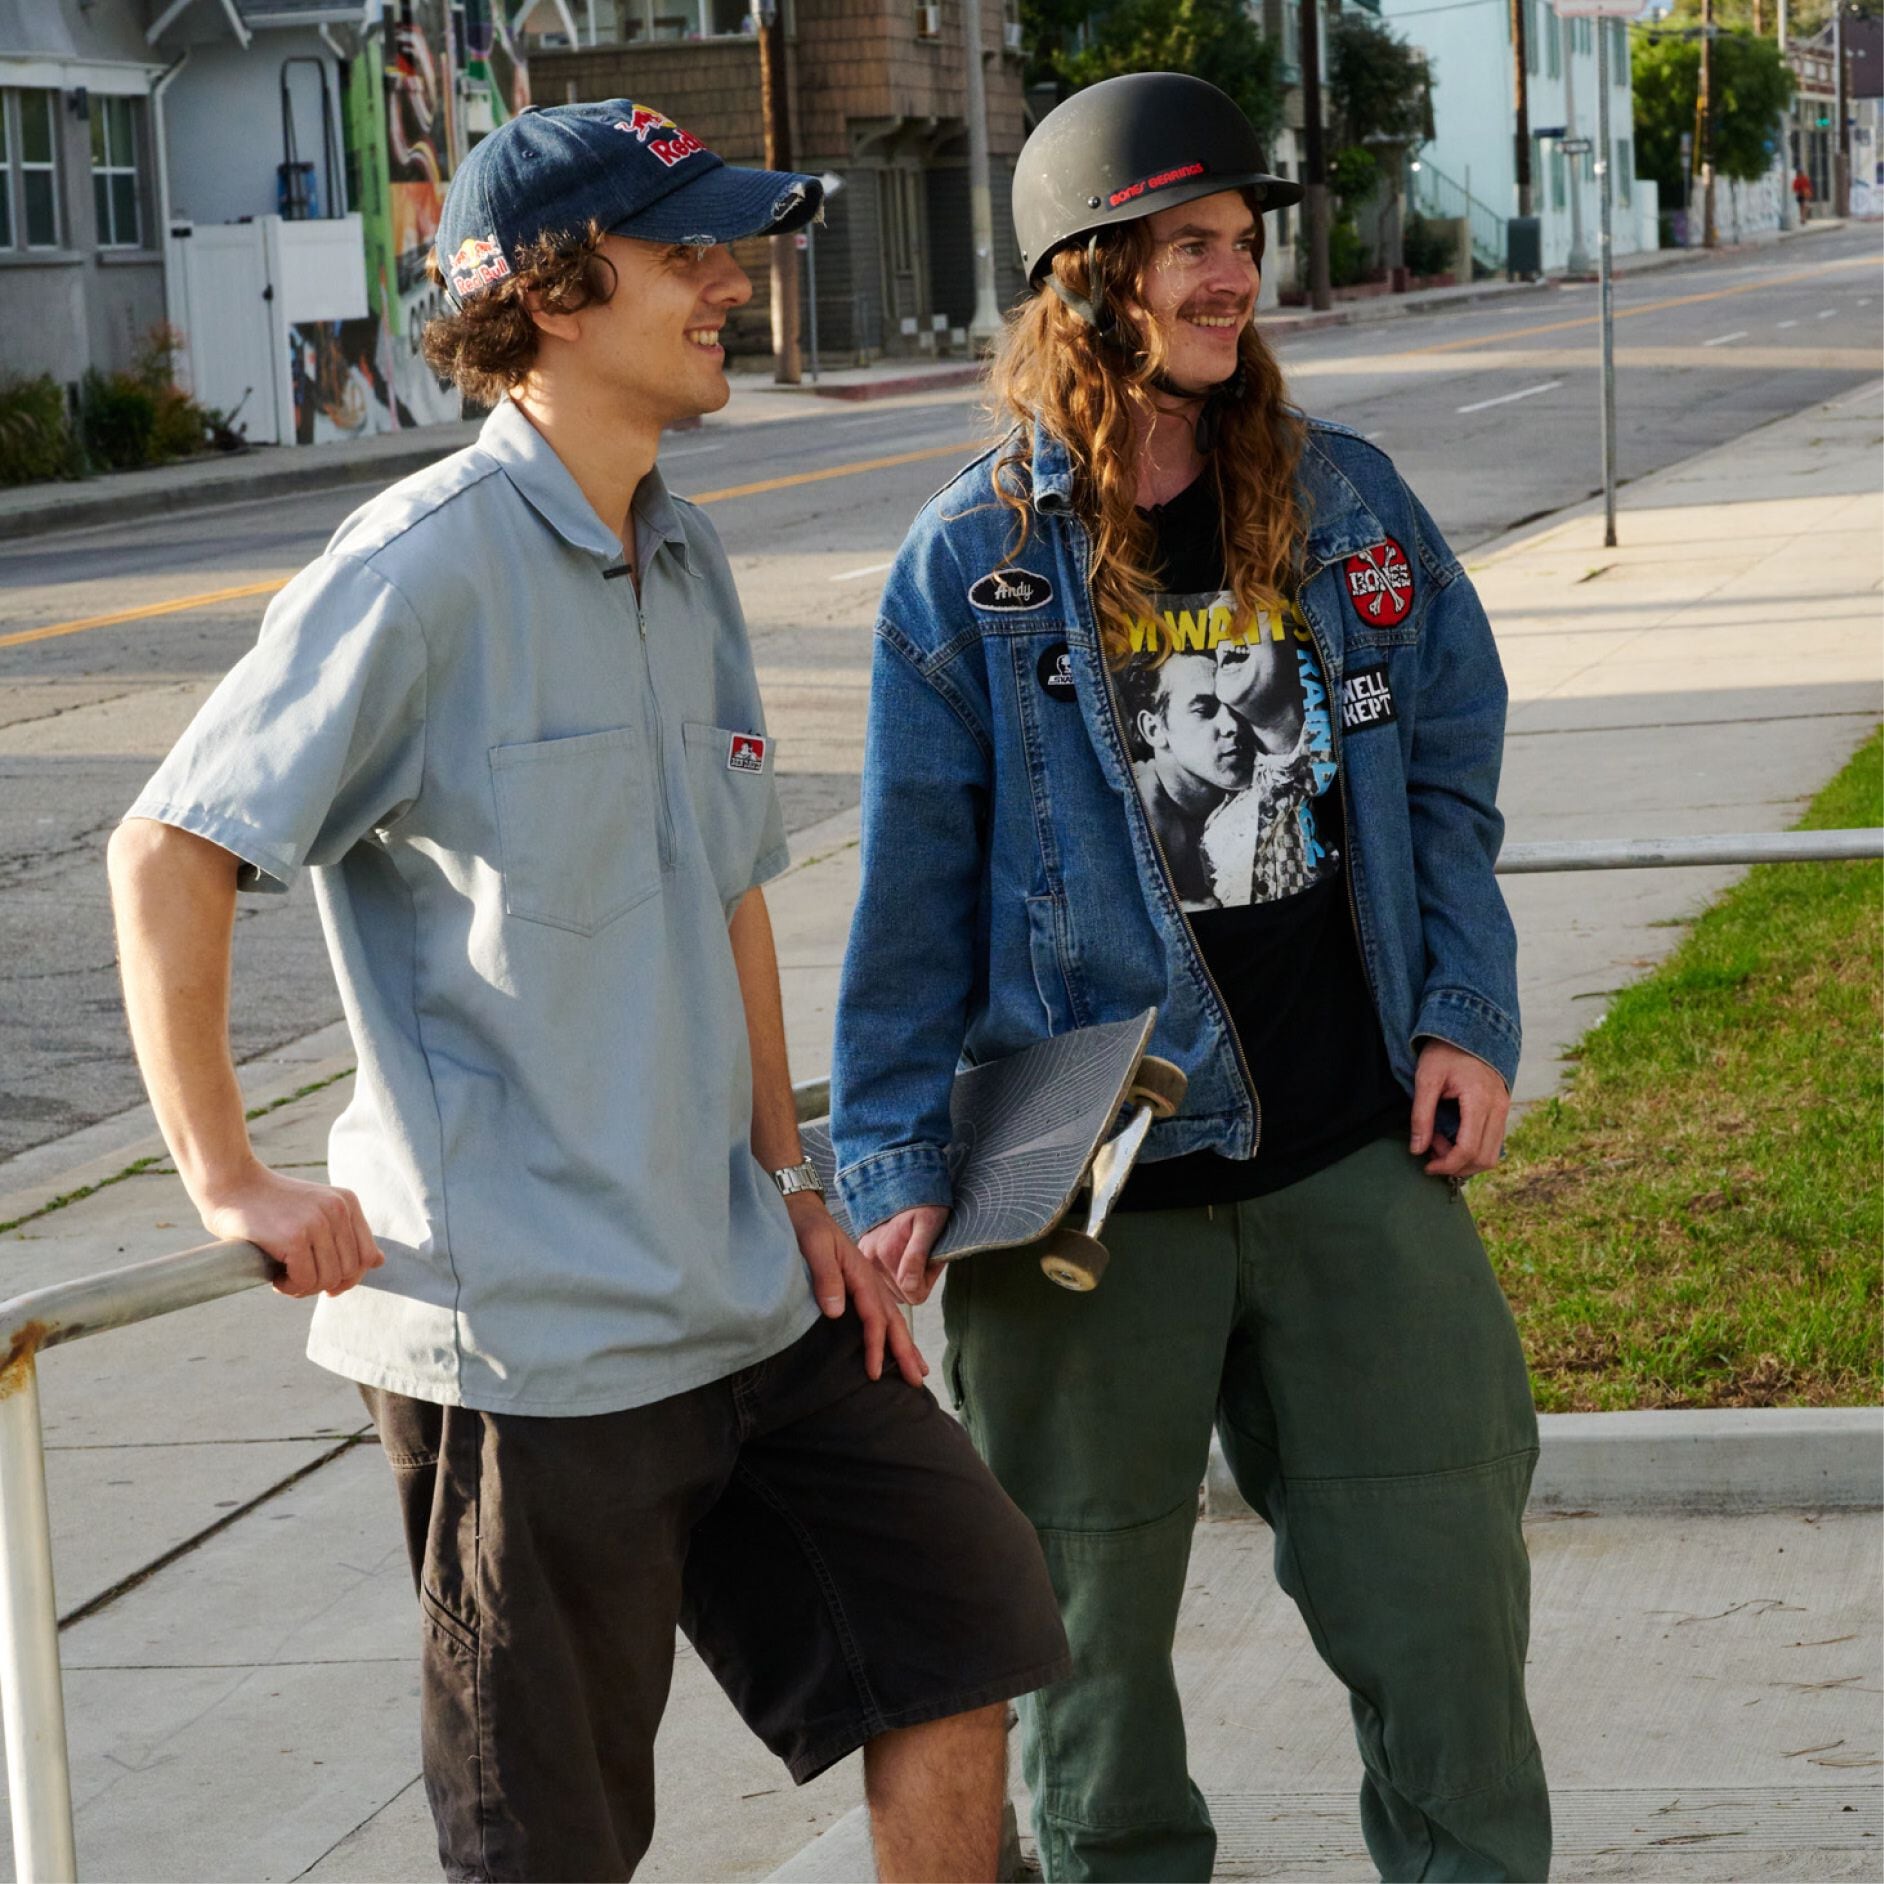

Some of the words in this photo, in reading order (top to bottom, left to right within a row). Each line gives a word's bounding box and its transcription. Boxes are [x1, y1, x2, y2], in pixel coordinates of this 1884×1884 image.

[647, 128, 706, 167] Red
[453, 276, 484, 296] Red
[478, 255, 511, 284] Bull
[994, 581, 1034, 601] Andy
[1343, 693, 1392, 728] KEPT
